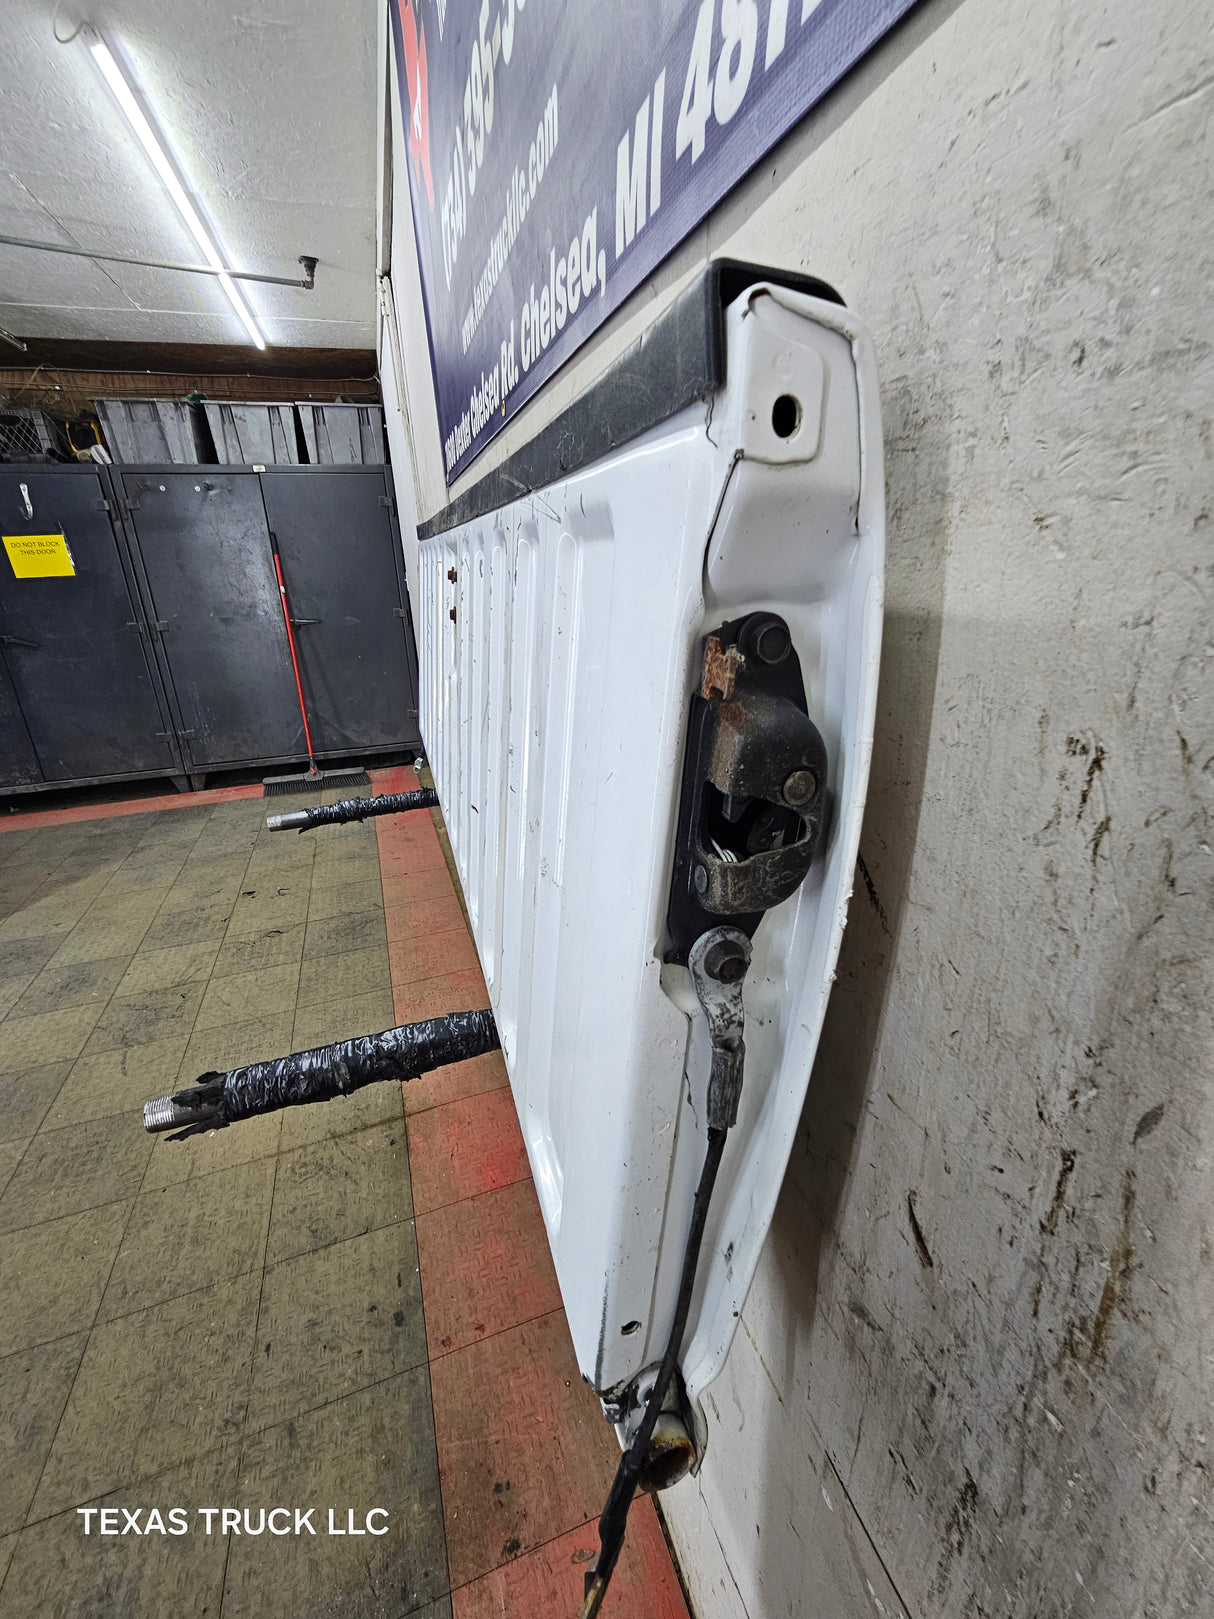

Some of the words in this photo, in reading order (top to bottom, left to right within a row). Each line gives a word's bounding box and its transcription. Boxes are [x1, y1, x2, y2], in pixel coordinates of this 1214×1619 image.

[441, 125, 467, 292] (734)
[463, 0, 525, 197] 395-
[470, 363, 500, 438] Chelsea
[501, 319, 519, 400] Rd.
[521, 206, 606, 372] Chelsea,
[616, 66, 666, 260] MI
[676, 0, 822, 165] 48
